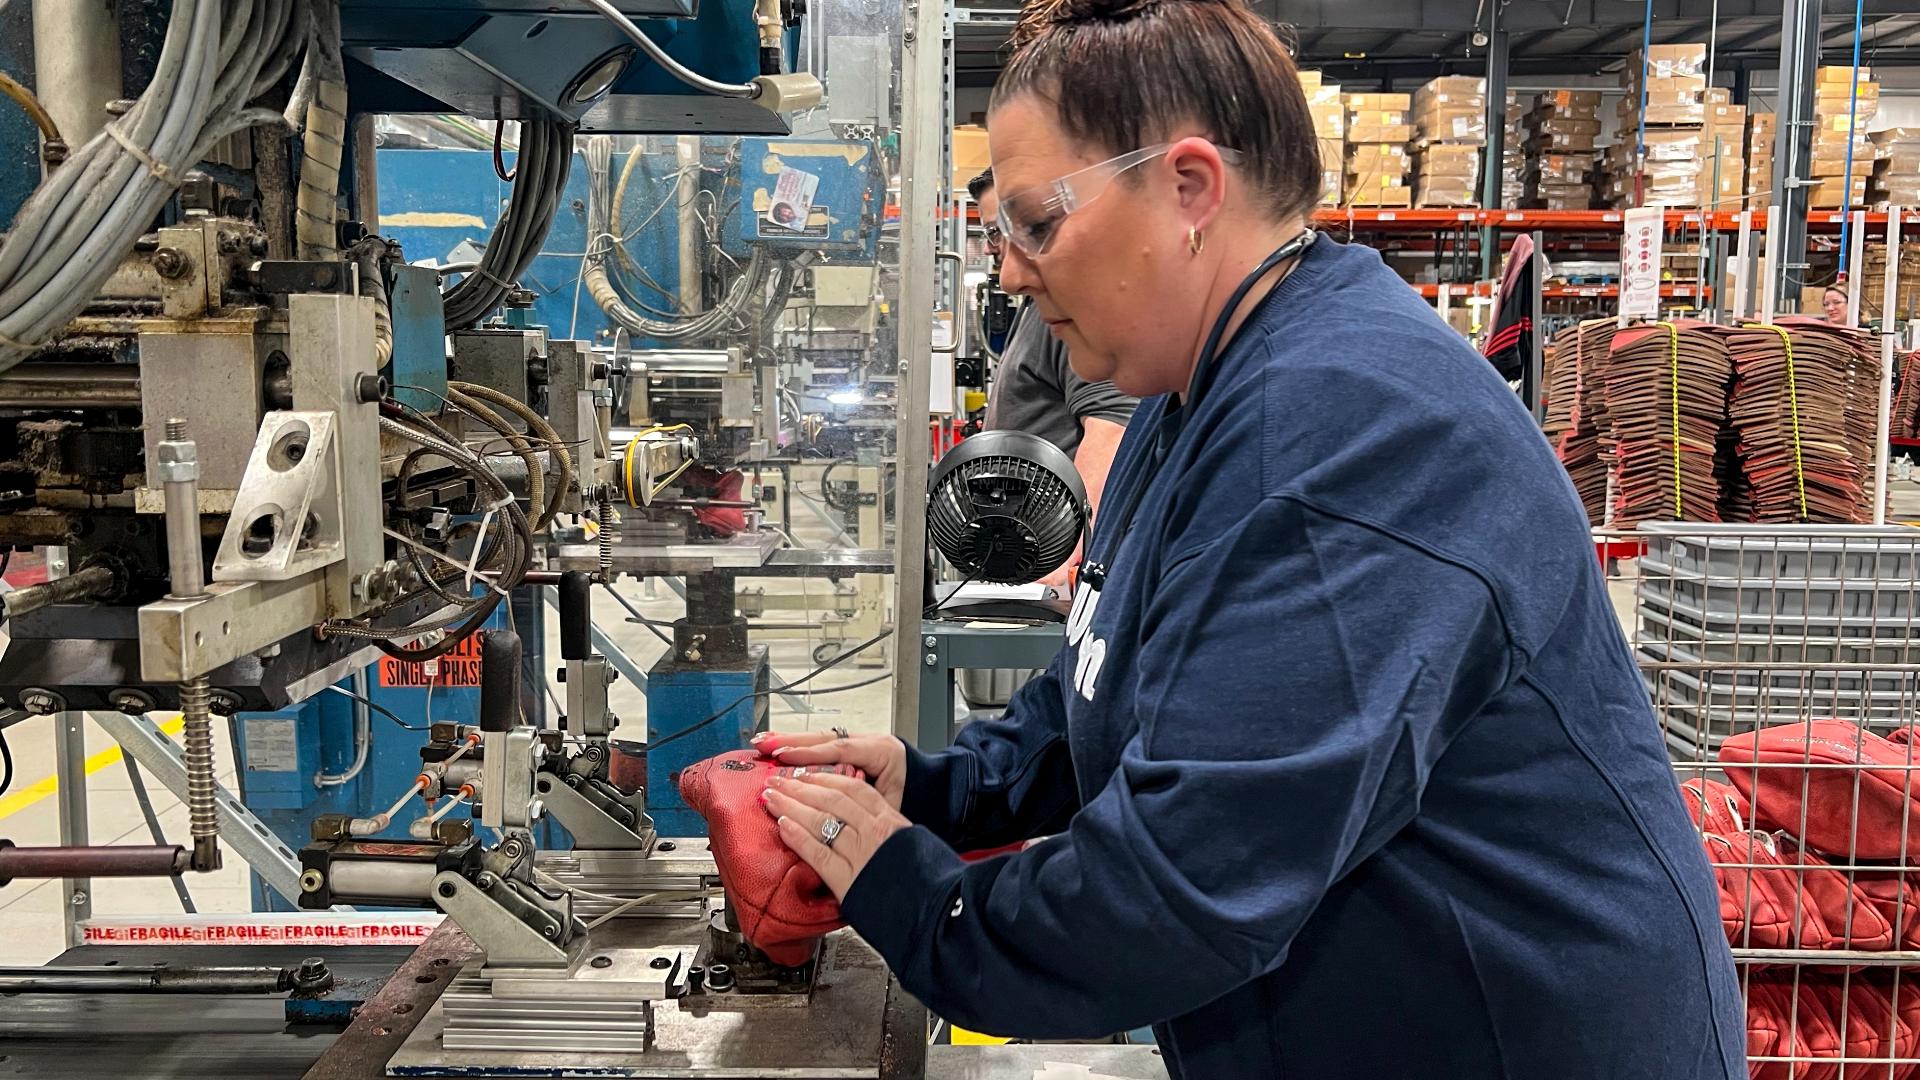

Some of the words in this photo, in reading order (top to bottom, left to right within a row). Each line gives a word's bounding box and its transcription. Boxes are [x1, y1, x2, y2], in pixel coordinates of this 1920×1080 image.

[387, 660, 434, 685] SINGL
[207, 926, 270, 939] FRAGILE
[285, 925, 347, 938] FRAGILE
[362, 925, 424, 937] FRAGILE
